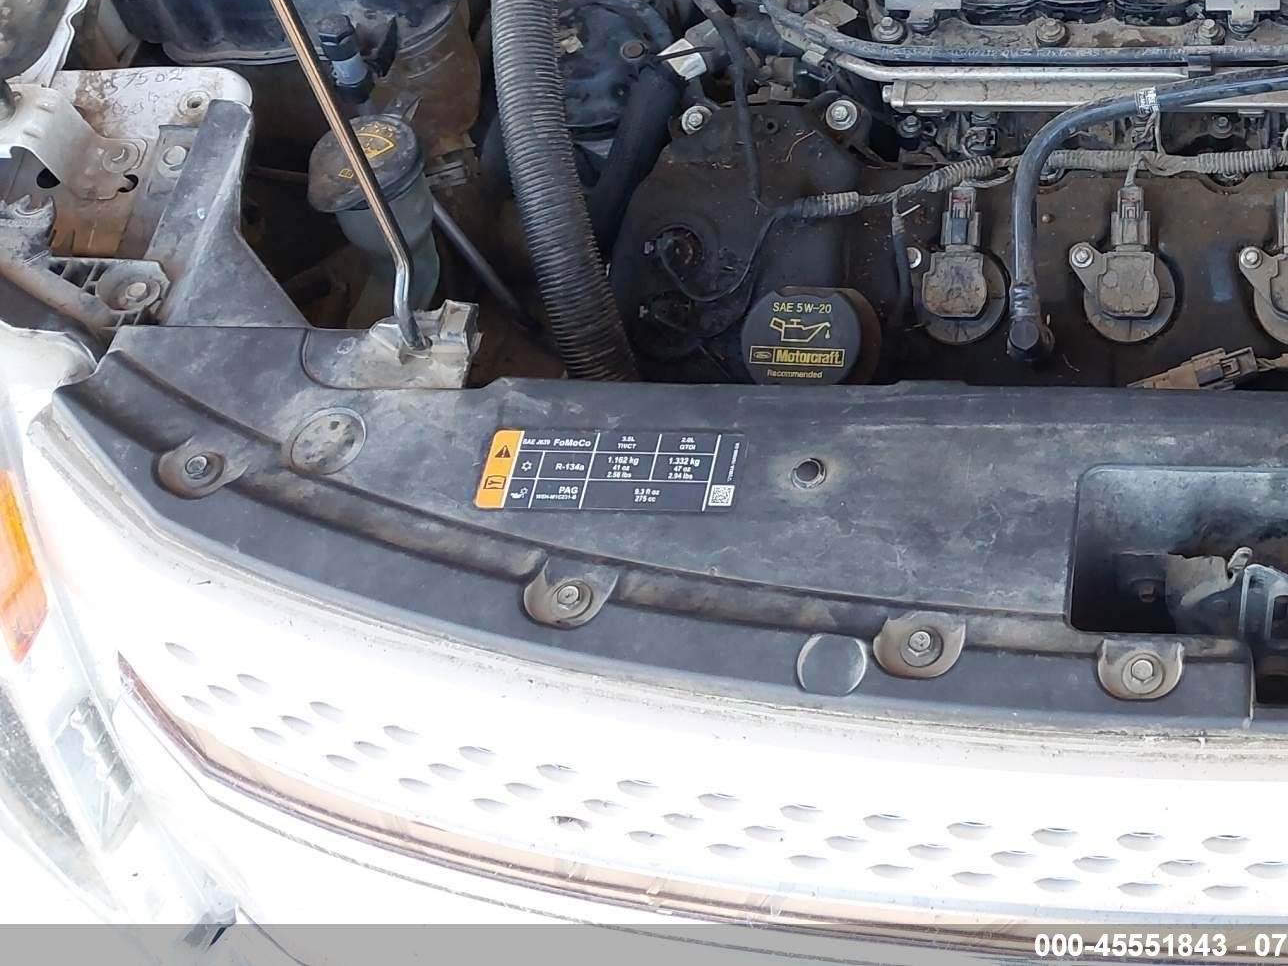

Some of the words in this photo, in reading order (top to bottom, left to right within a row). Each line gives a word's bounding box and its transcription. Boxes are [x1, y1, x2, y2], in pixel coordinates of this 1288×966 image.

[772, 302, 794, 313] SAE
[796, 302, 832, 314] 5W-20
[775, 349, 840, 365] Motorcraft
[767, 369, 823, 379] Recommended
[553, 438, 592, 447] FoMoCo
[607, 456, 629, 464] 1.162
[629, 456, 640, 466] kg
[668, 457, 689, 465] 1.332
[689, 457, 700, 467] kg
[555, 462, 585, 471] R-134a
[682, 472, 693, 480] lbs
[558, 486, 579, 494] PAG
